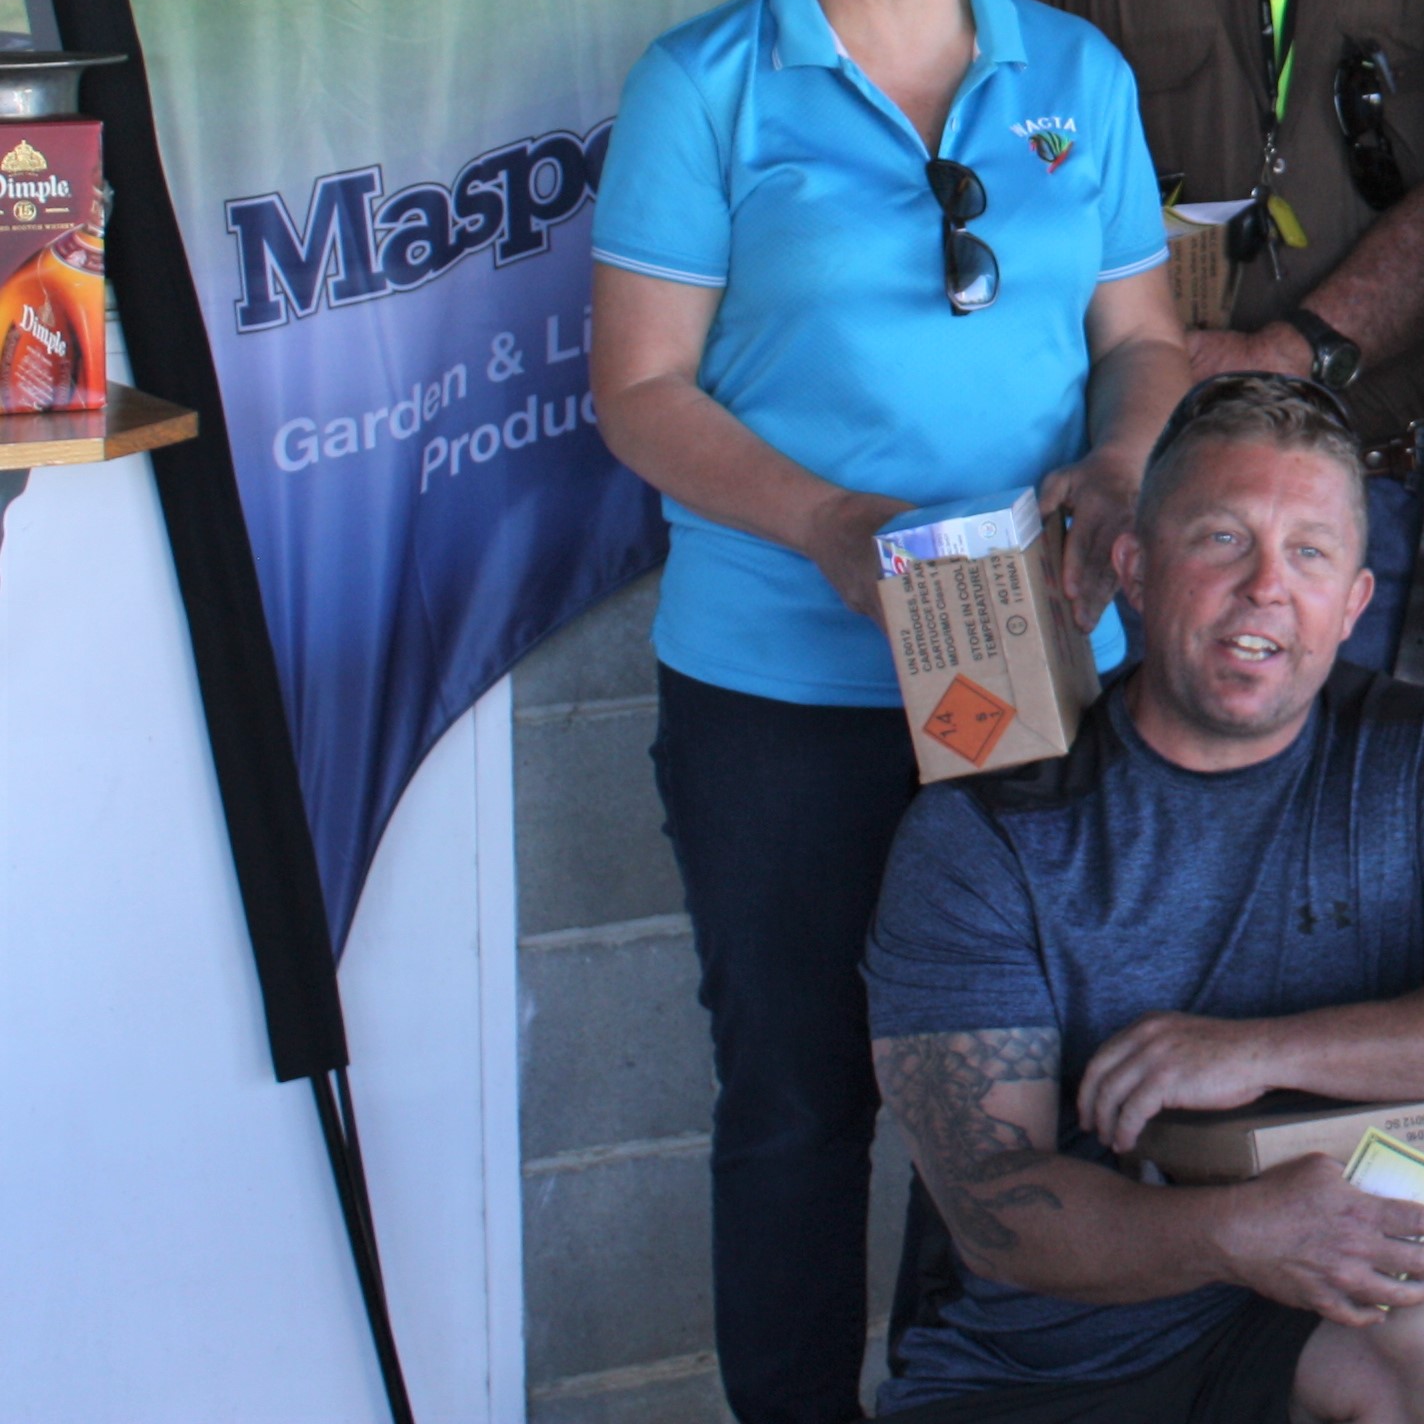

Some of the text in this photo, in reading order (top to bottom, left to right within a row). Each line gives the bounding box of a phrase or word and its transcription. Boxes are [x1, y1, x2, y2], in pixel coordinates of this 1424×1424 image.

[0, 173, 70, 204] imple
[17, 203, 33, 216] 15
[19, 303, 67, 357] Dimple
[273, 361, 468, 474] Garden
[484, 331, 525, 383] &
[1006, 560, 1021, 591] RINA
[917, 580, 930, 605] PER
[952, 565, 983, 662] STORE IN COOL
[968, 565, 998, 659] TEMPERATURE
[923, 605, 946, 670] CARTUCCE
[907, 656, 919, 676] UN
[935, 710, 958, 739] 1.4
